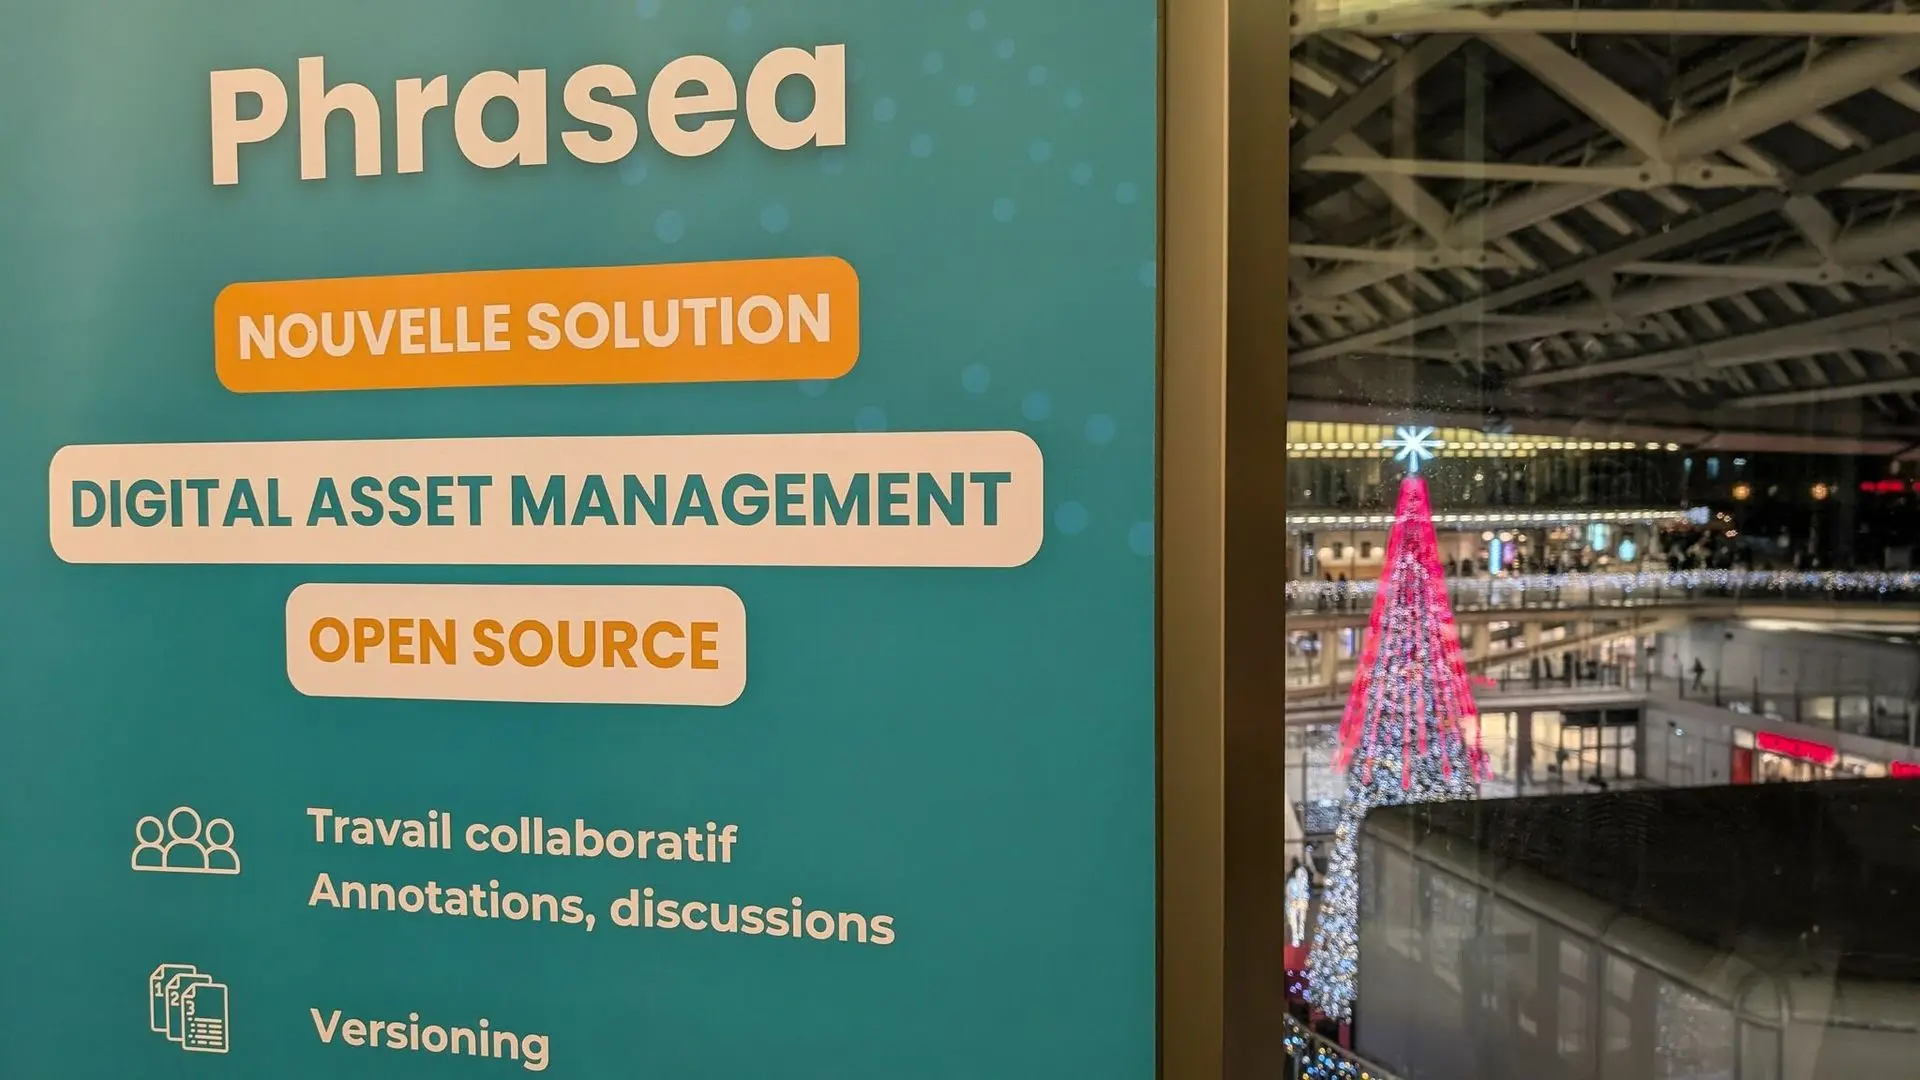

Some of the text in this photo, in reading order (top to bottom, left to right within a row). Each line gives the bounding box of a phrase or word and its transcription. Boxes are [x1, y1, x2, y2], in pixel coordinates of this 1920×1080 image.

[208, 43, 847, 186] Phrasea
[238, 293, 831, 360] NOUVELLE SOLUTION
[72, 471, 1012, 528] DIGITAL ASSET MANAGEMENT
[309, 616, 719, 670] OPEN SOURCE
[306, 807, 739, 863] Travail collaboratif
[308, 872, 895, 945] Annotations, discussions
[154, 981, 164, 997] 1
[170, 990, 180, 1007] 2
[185, 999, 196, 1016] 3
[310, 1007, 549, 1072] Versioning
